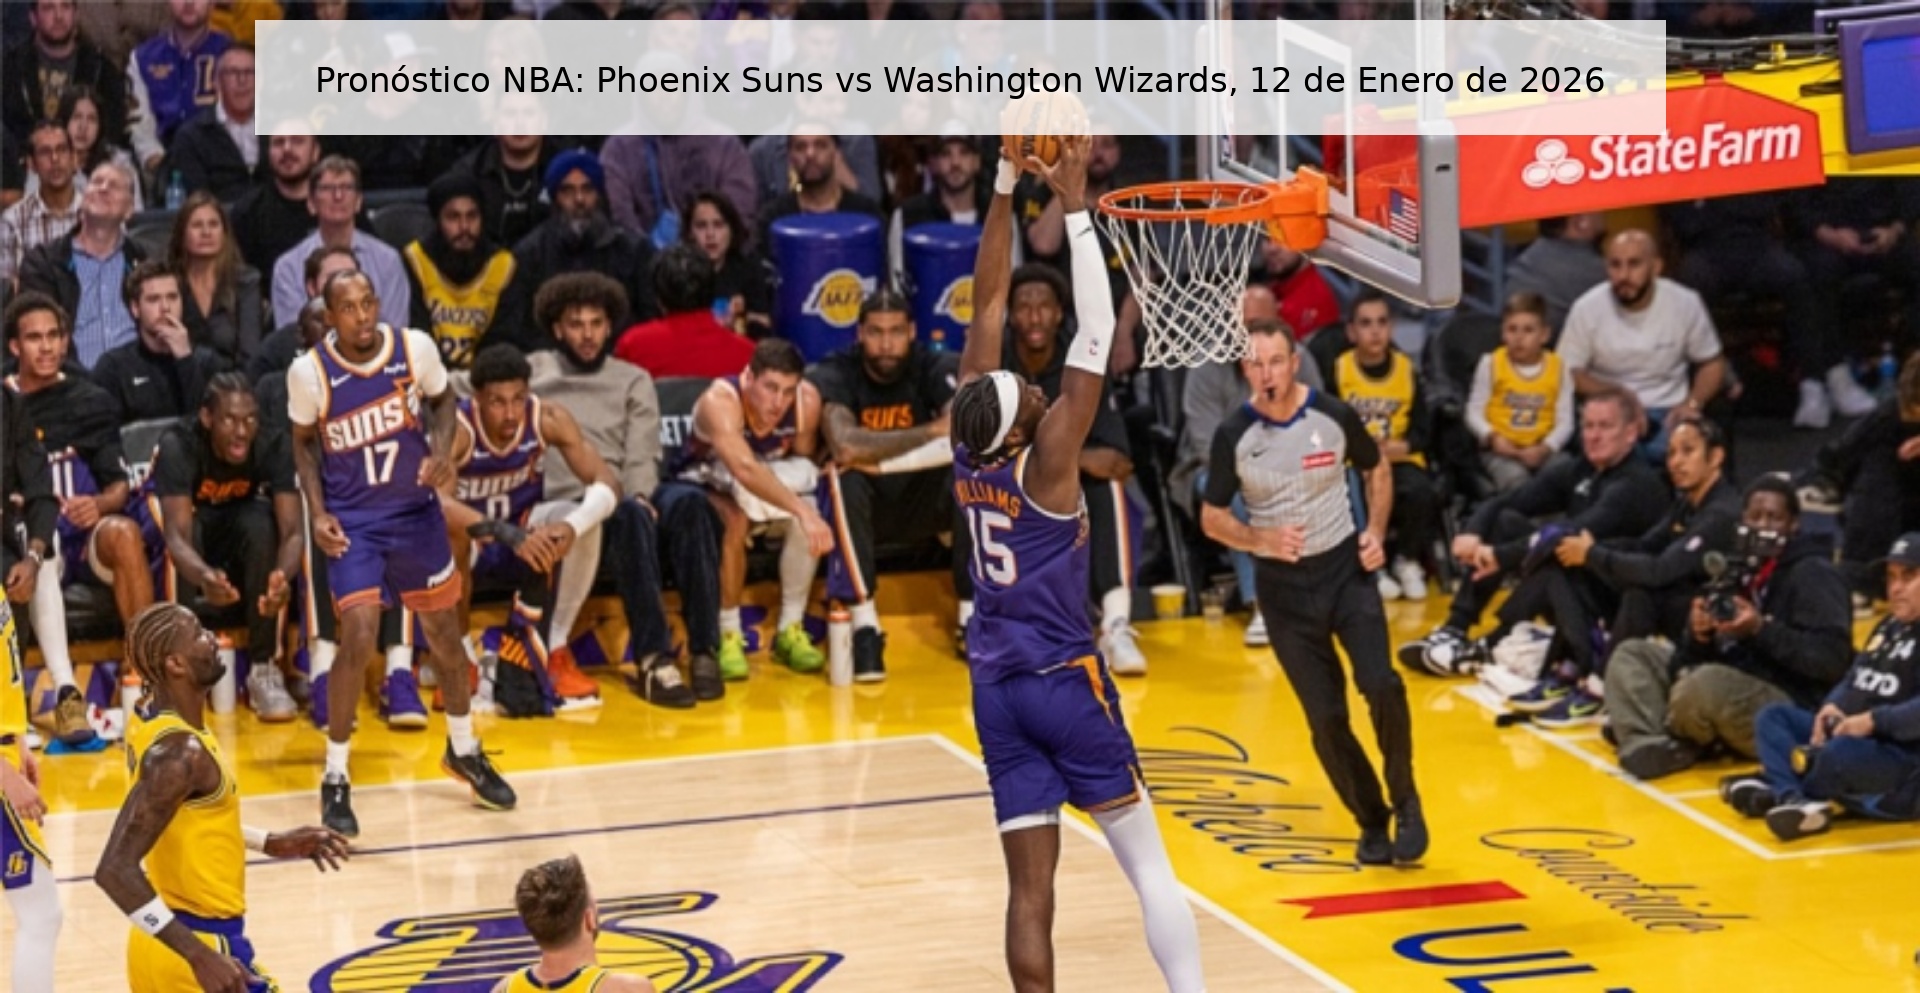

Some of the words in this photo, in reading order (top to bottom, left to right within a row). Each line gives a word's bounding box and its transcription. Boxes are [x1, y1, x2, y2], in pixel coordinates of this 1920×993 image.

[326, 396, 405, 450] SUNS
[363, 440, 400, 486] 17
[966, 505, 1018, 587] 15
